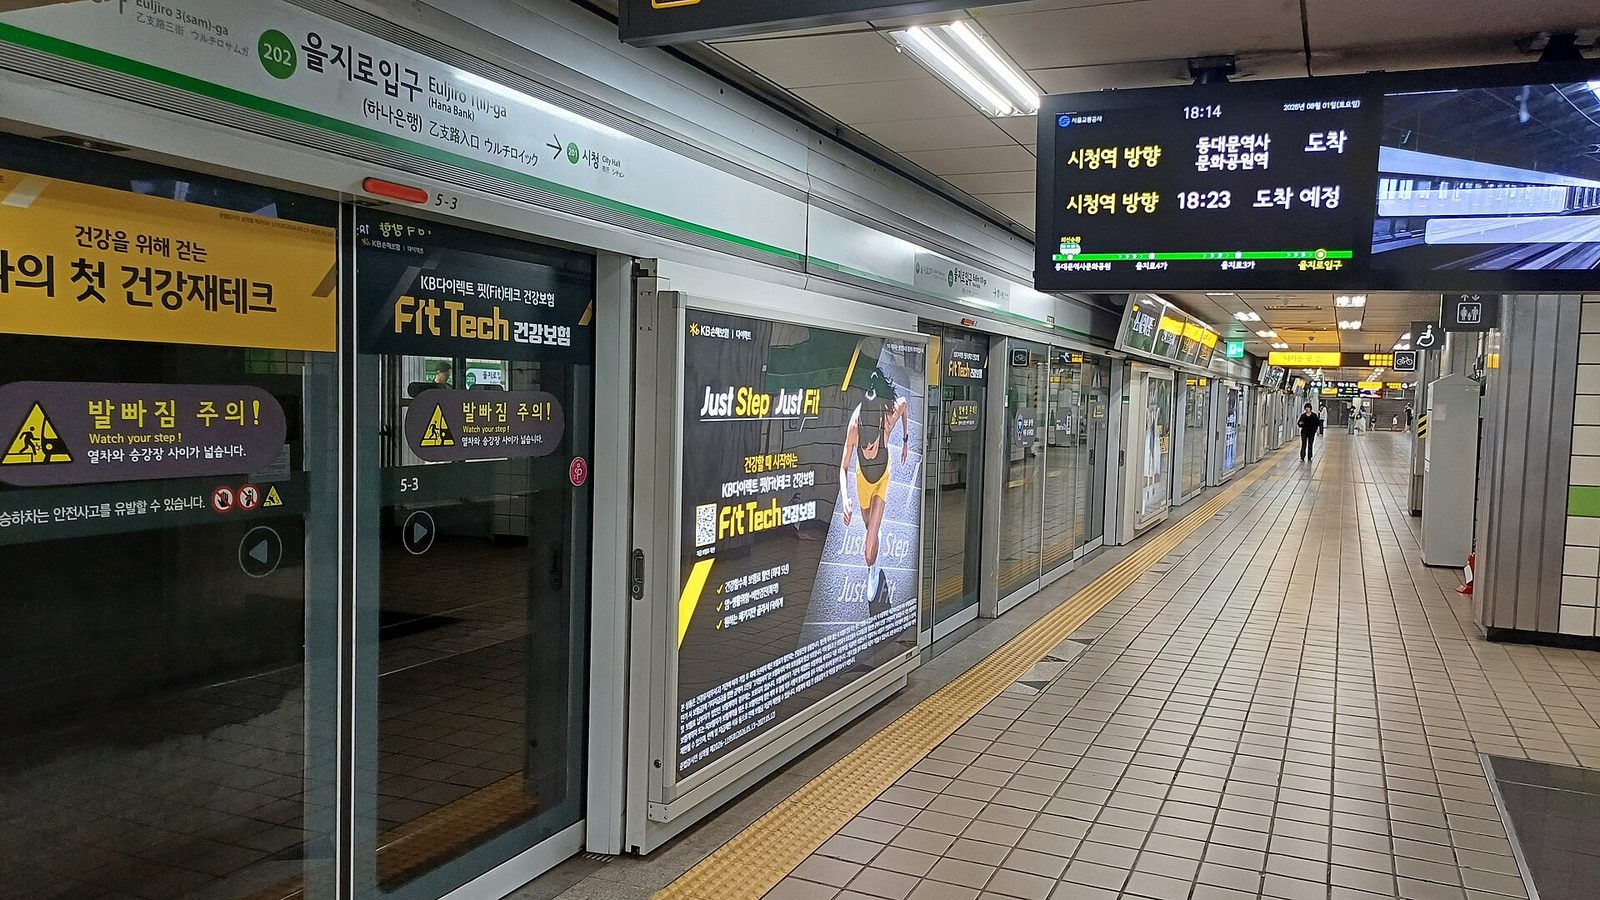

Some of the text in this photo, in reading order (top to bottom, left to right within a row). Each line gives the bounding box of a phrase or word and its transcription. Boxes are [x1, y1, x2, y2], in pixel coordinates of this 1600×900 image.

[175, 9, 229, 36] 3(sam)-ga
[263, 43, 292, 67] 202
[300, 31, 423, 102] 을지로입구
[428, 77, 467, 104] Euljiro
[362, 97, 424, 134] (하나은행)
[428, 96, 475, 122] (Hana Bank)
[1184, 104, 1222, 120] 18:14
[429, 120, 480, 150] 乙支路入口
[1196, 132, 1272, 154] 동대문역사
[1304, 129, 1348, 154] 도착
[582, 149, 600, 170] 시청
[602, 155, 621, 168] City Hall
[1067, 144, 1162, 170] 시청역 방향
[1195, 151, 1269, 172] 문화공원역
[434, 193, 458, 210] 5-3
[1066, 191, 1160, 215] 시청역 방향
[1177, 190, 1231, 210] 18:23
[1252, 184, 1340, 210] 도착 예정
[75, 225, 207, 263] 건강을 위해 걷는
[71, 258, 106, 304] 첫
[121, 265, 277, 315] 건강재테크
[420, 275, 555, 308] KB다이렉트 핏(Fit)테크 건강보험
[394, 295, 509, 342] Fit Tech
[513, 321, 571, 347] 건강보험
[700, 385, 821, 419] Just Step Just Fit
[89, 431, 125, 445] Watch
[127, 434, 152, 446] your
[461, 436, 480, 448] 열차와
[481, 435, 500, 447] 승강장
[502, 434, 519, 445] 사이가
[462, 425, 481, 434] Watch
[482, 426, 495, 436] your
[87, 443, 247, 465] 열차와 승강장 사이가 넓습니다.
[400, 477, 419, 492] 5-3
[53, 497, 111, 523] 안전사고를
[114, 494, 147, 516] 유발할
[150, 494, 160, 514] 수
[163, 490, 206, 511] 있습니다.
[718, 497, 782, 540] Fit Tech
[782, 500, 816, 525] 건강보험
[883, 532, 909, 567] Step
[838, 575, 867, 603] Just
